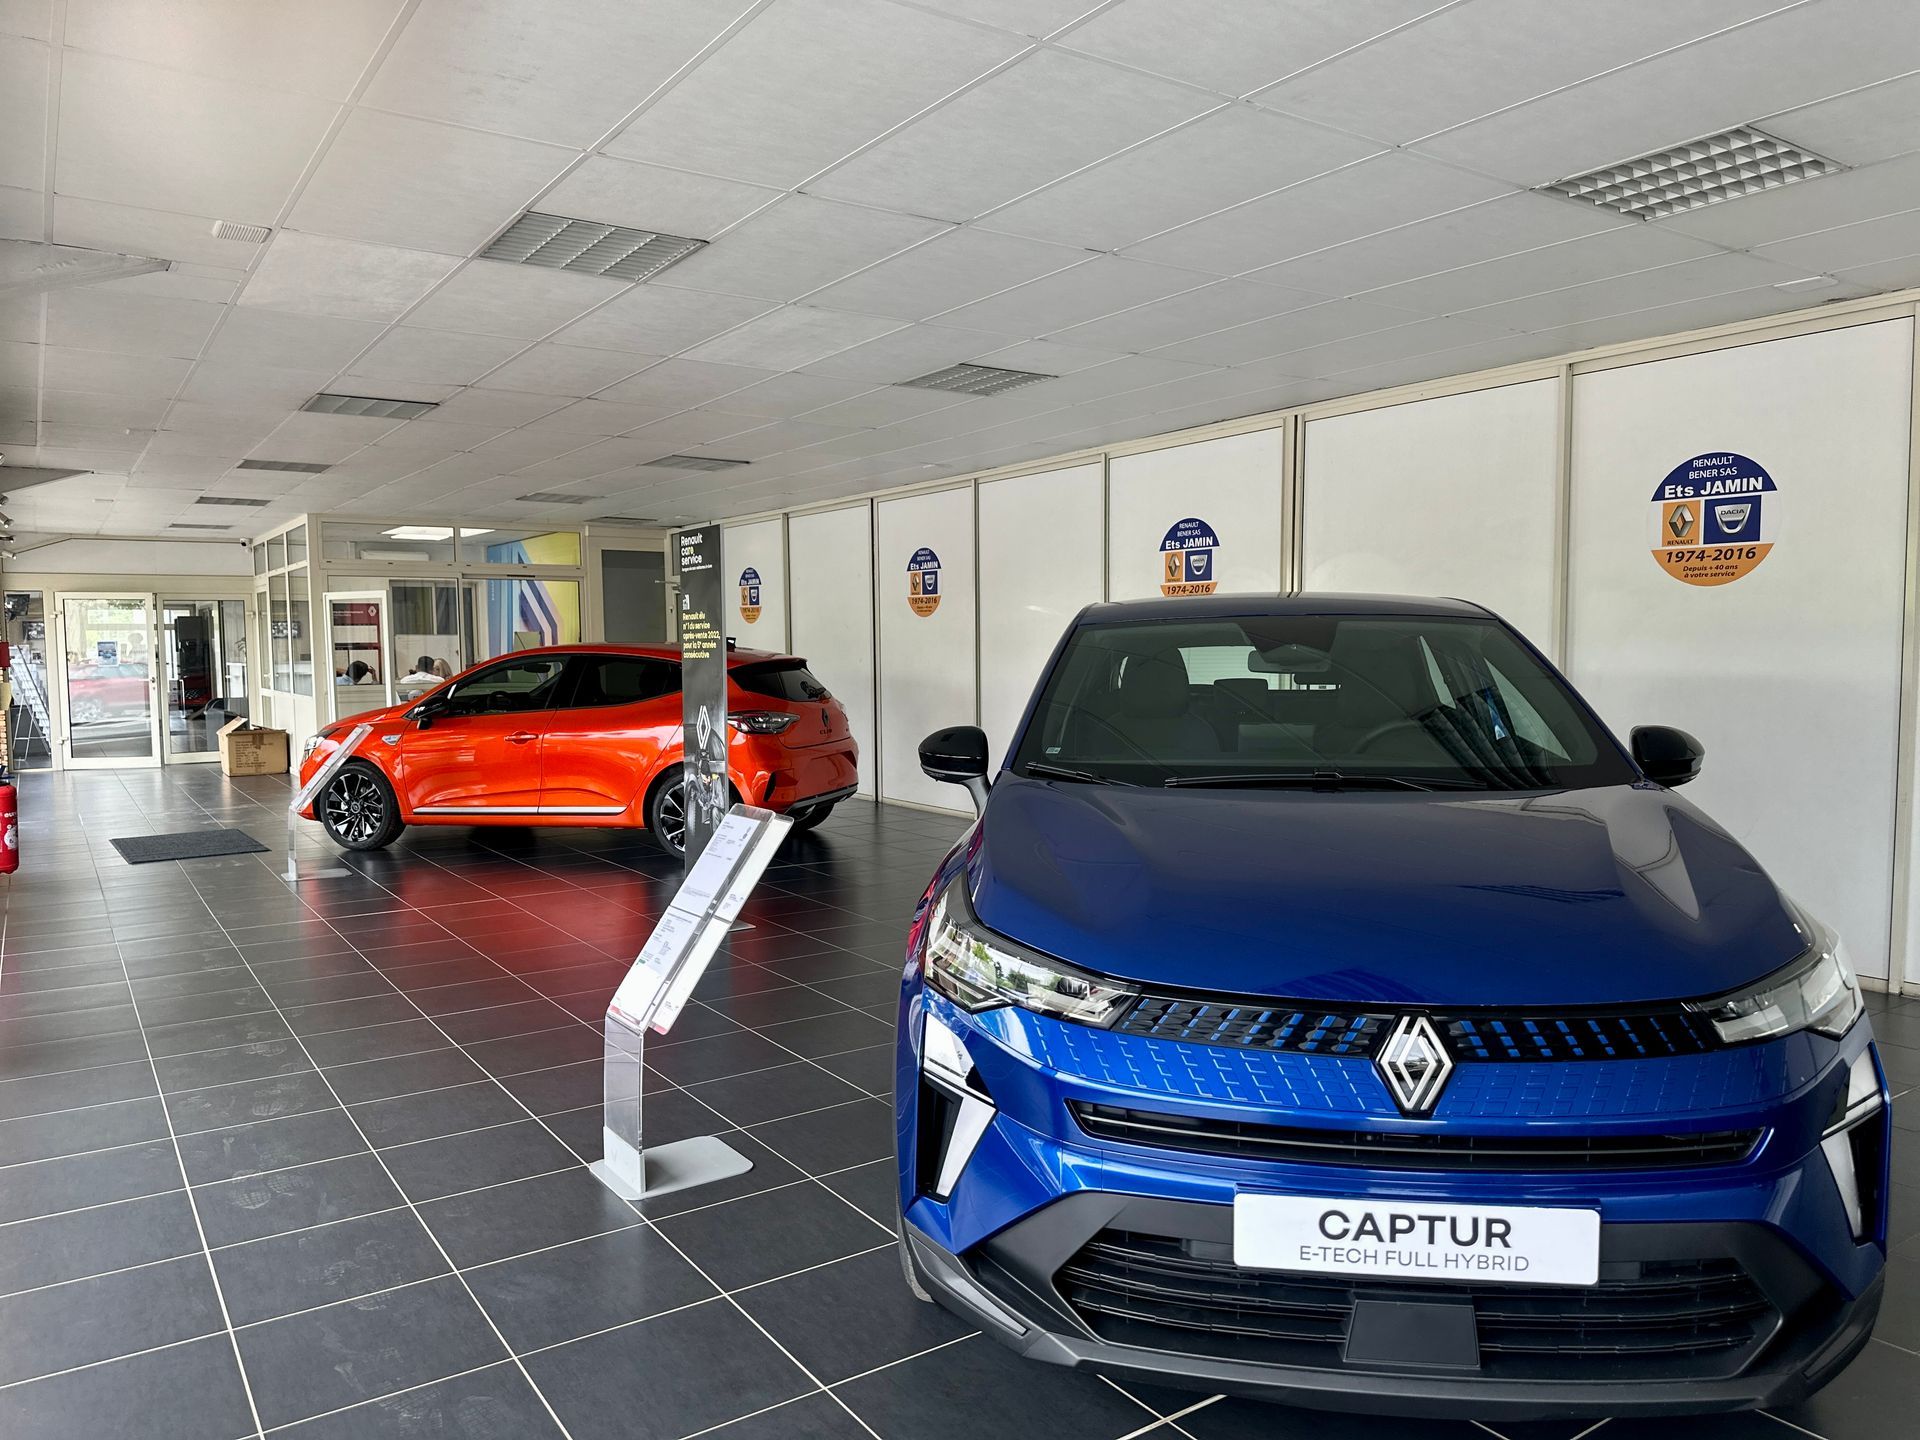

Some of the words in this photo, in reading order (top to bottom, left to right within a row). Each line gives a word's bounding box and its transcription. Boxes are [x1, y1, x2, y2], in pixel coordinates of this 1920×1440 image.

[1693, 456, 1734, 468] RENAULT
[1688, 469, 1718, 479] BENER
[1719, 467, 1738, 476] SAS
[1664, 484, 1694, 498] Ets
[1700, 477, 1763, 496] JAMIN
[681, 532, 703, 546] Renault
[1165, 540, 1180, 550] Ets
[1183, 536, 1213, 548] JAMIN
[681, 546, 694, 556] care
[1666, 547, 1757, 563] 1974-2016
[681, 553, 702, 566] service
[920, 561, 938, 570] JAMIN
[1167, 584, 1211, 595] 1974-2016
[1318, 1208, 1512, 1248] CAPTUR
[1299, 1245, 1379, 1265] E-TECH
[1385, 1250, 1438, 1268] FULL
[1444, 1253, 1530, 1272] HYBRID
